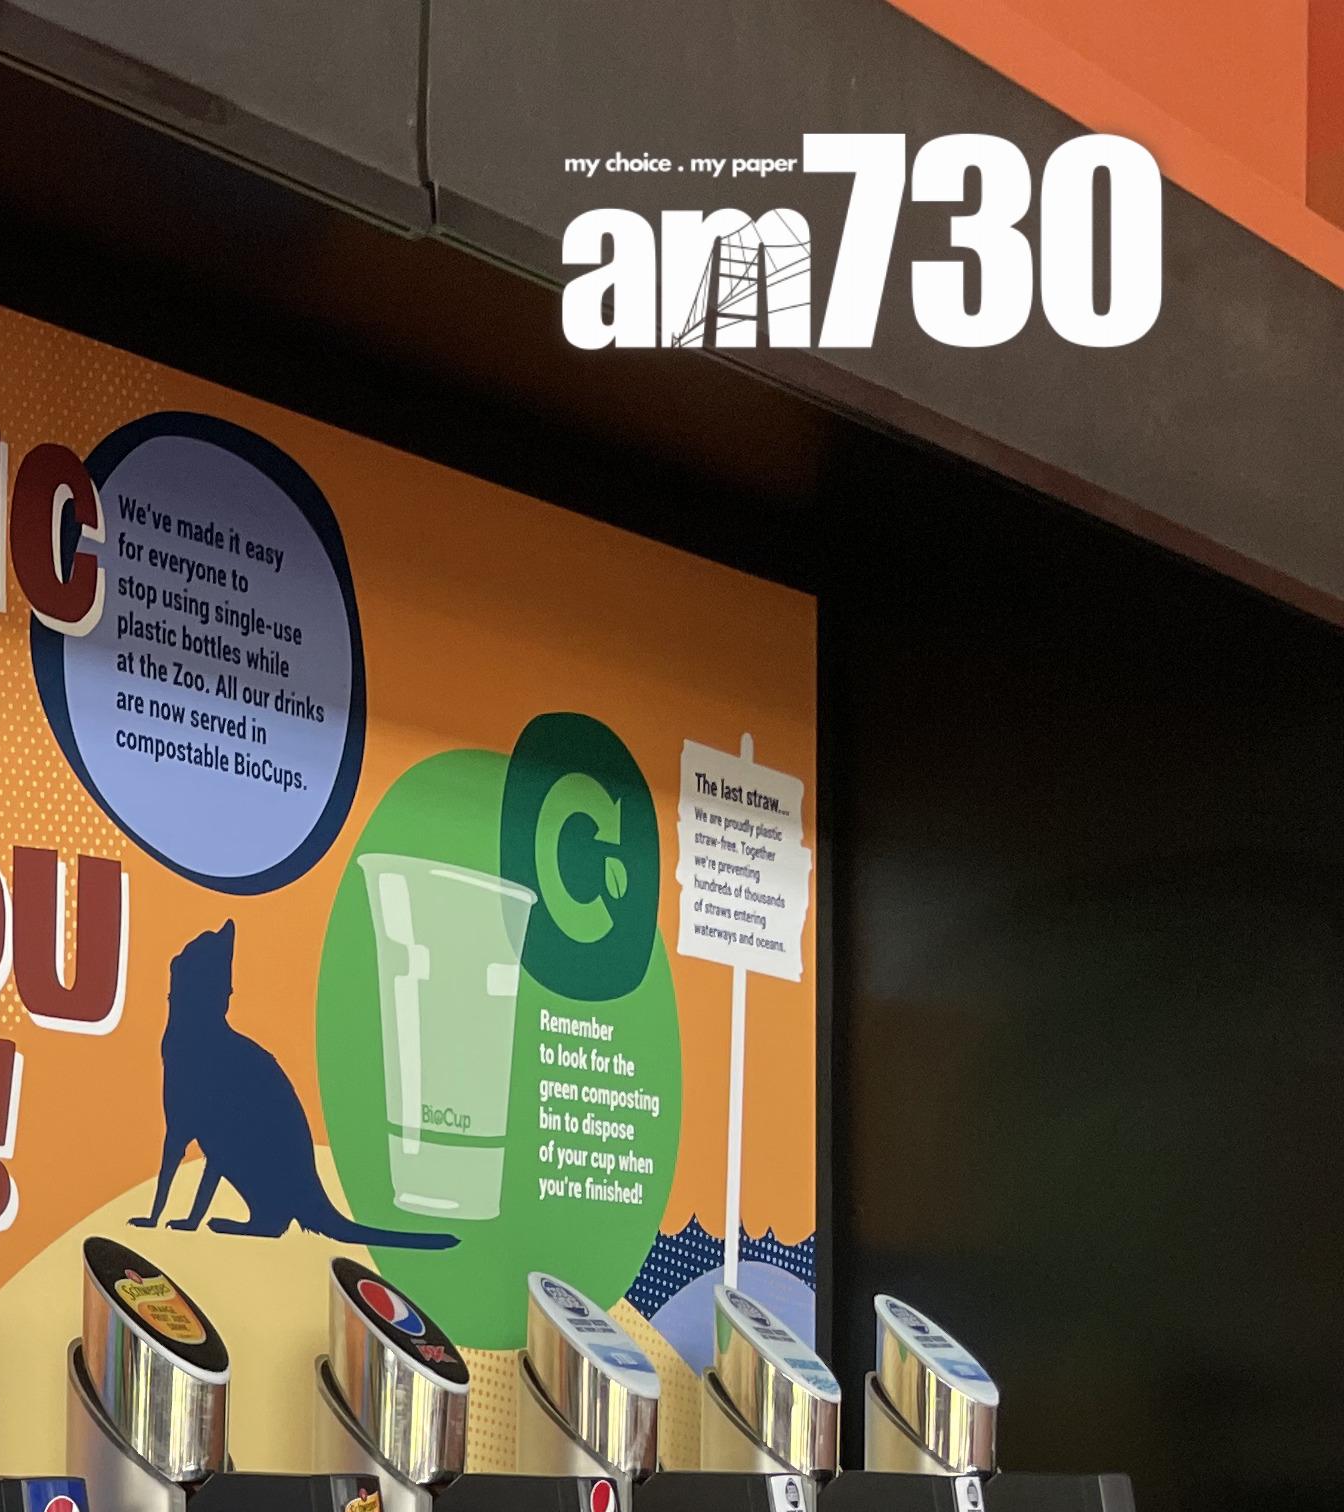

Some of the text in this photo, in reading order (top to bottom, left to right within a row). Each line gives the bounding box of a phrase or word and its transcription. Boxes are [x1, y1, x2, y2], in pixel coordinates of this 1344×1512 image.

[119, 495, 284, 573] We've made it easy
[119, 533, 248, 592] for everyone to
[119, 576, 302, 645] stop using single-use
[118, 613, 289, 678] plastic bottles while
[117, 652, 324, 723] at the Zoo. All our drinks
[117, 691, 266, 744] are now served in
[116, 727, 307, 792] compostable BioCups.
[695, 773, 789, 816] The last straw...
[695, 807, 782, 842] We are proudly plastic
[695, 832, 775, 862] straw-free. Together
[695, 855, 760, 884] we're preventing
[694, 874, 785, 909] hundreds of thousands
[694, 899, 766, 929] of straws entering
[694, 923, 786, 953] waterways and oceans.
[540, 1009, 614, 1041] Remember
[540, 1043, 634, 1077] to look for the
[540, 1079, 660, 1117] green composting
[422, 1104, 471, 1129] BioCup
[540, 1107, 634, 1141] bin to dispose
[540, 1141, 653, 1174] of your cup when
[539, 1177, 643, 1205] you're finished!
